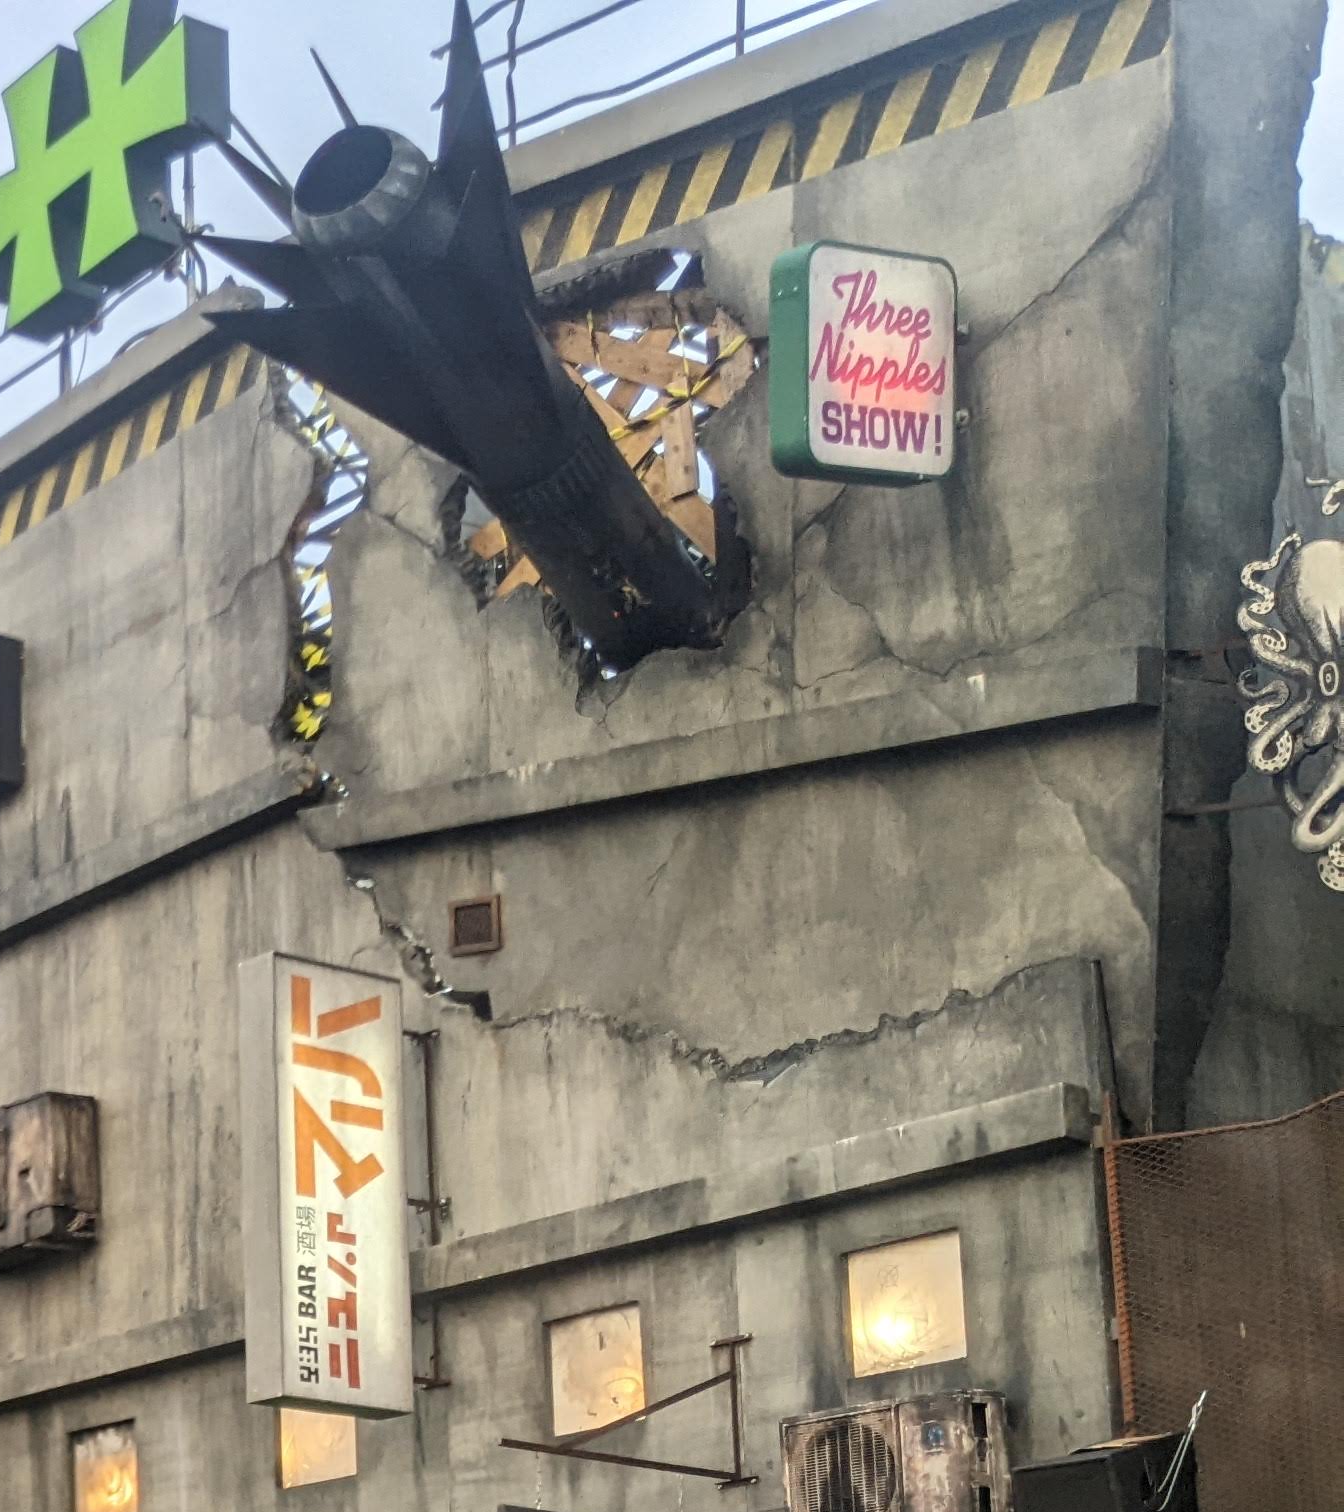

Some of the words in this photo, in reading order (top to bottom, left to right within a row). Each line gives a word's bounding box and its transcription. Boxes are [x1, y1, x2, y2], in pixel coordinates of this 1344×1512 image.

[832, 270, 932, 340] Three
[810, 322, 947, 402] Nipples
[297, 1263, 318, 1321] BAR
